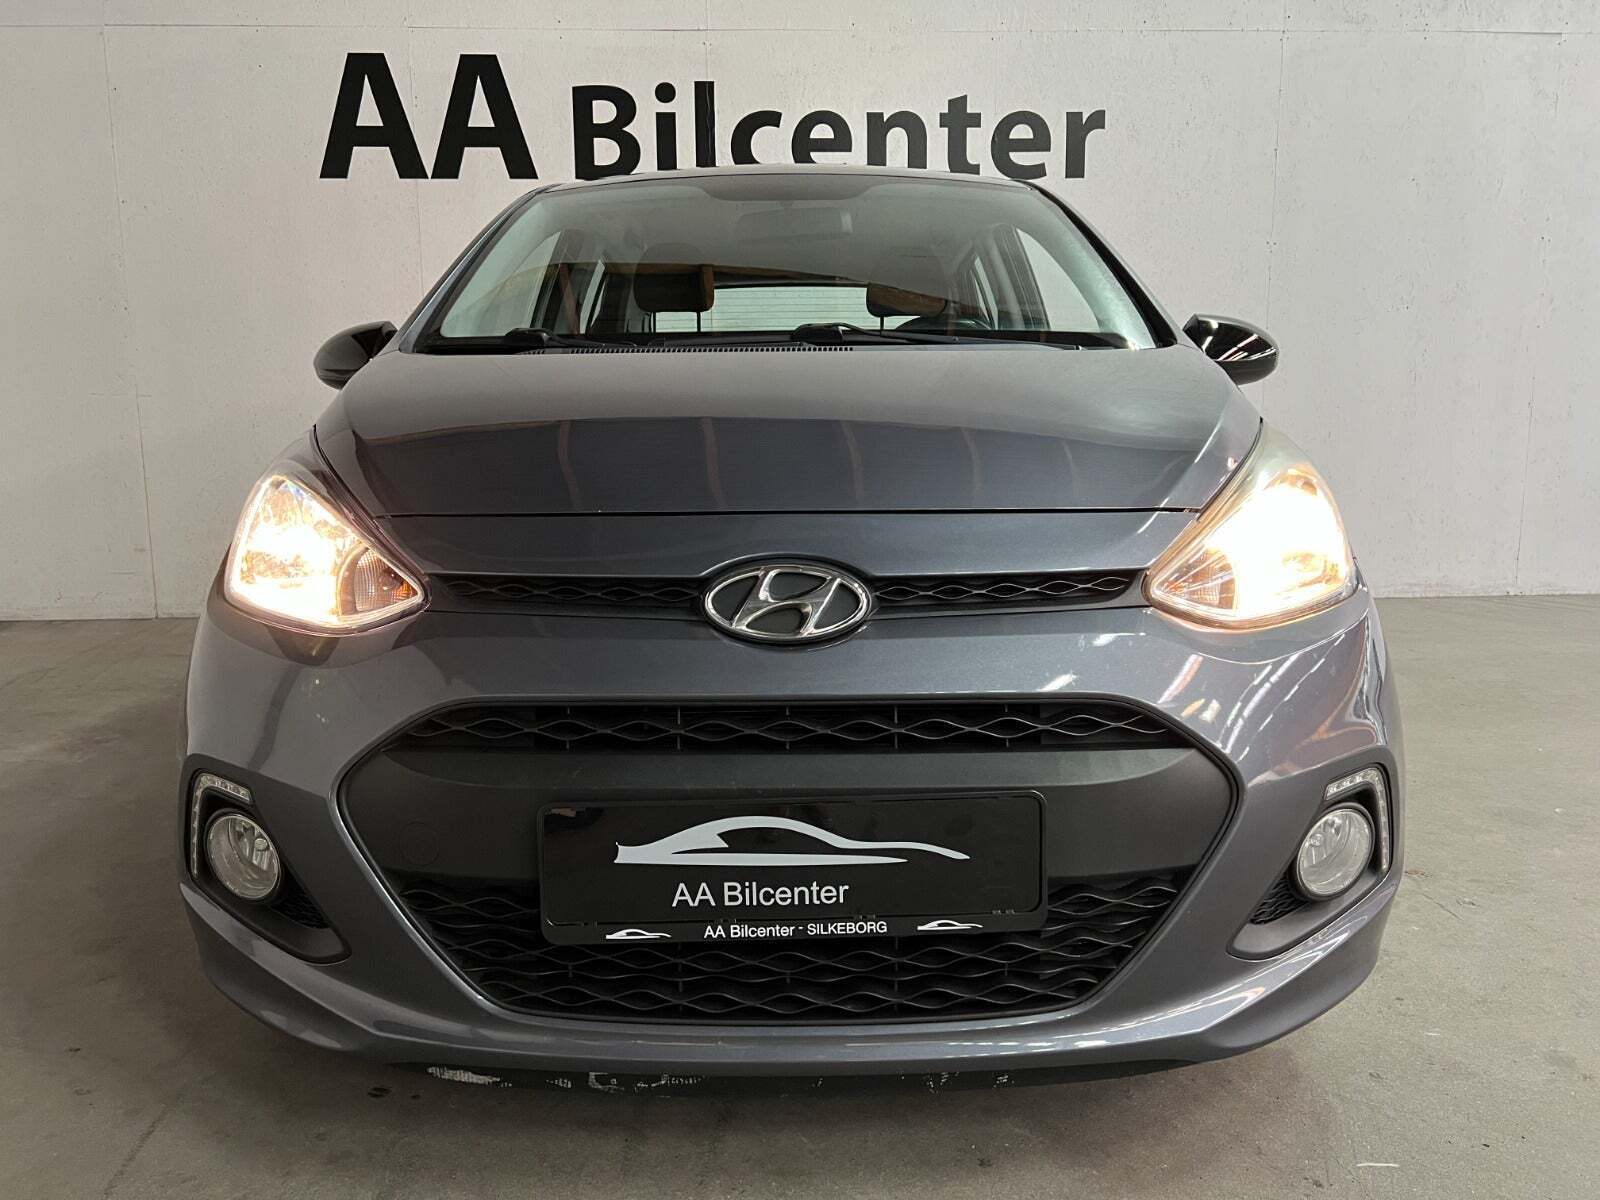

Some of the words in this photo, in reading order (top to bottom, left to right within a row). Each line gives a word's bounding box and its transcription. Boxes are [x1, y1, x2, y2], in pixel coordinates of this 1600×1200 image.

[320, 53, 538, 180] AA
[572, 81, 1106, 181] Bilcenter
[672, 882, 715, 907] AA
[723, 880, 849, 906] Bilcenter
[703, 925, 726, 939] AA
[730, 924, 795, 938] Bilcenter
[807, 921, 888, 936] SILKEBORG
